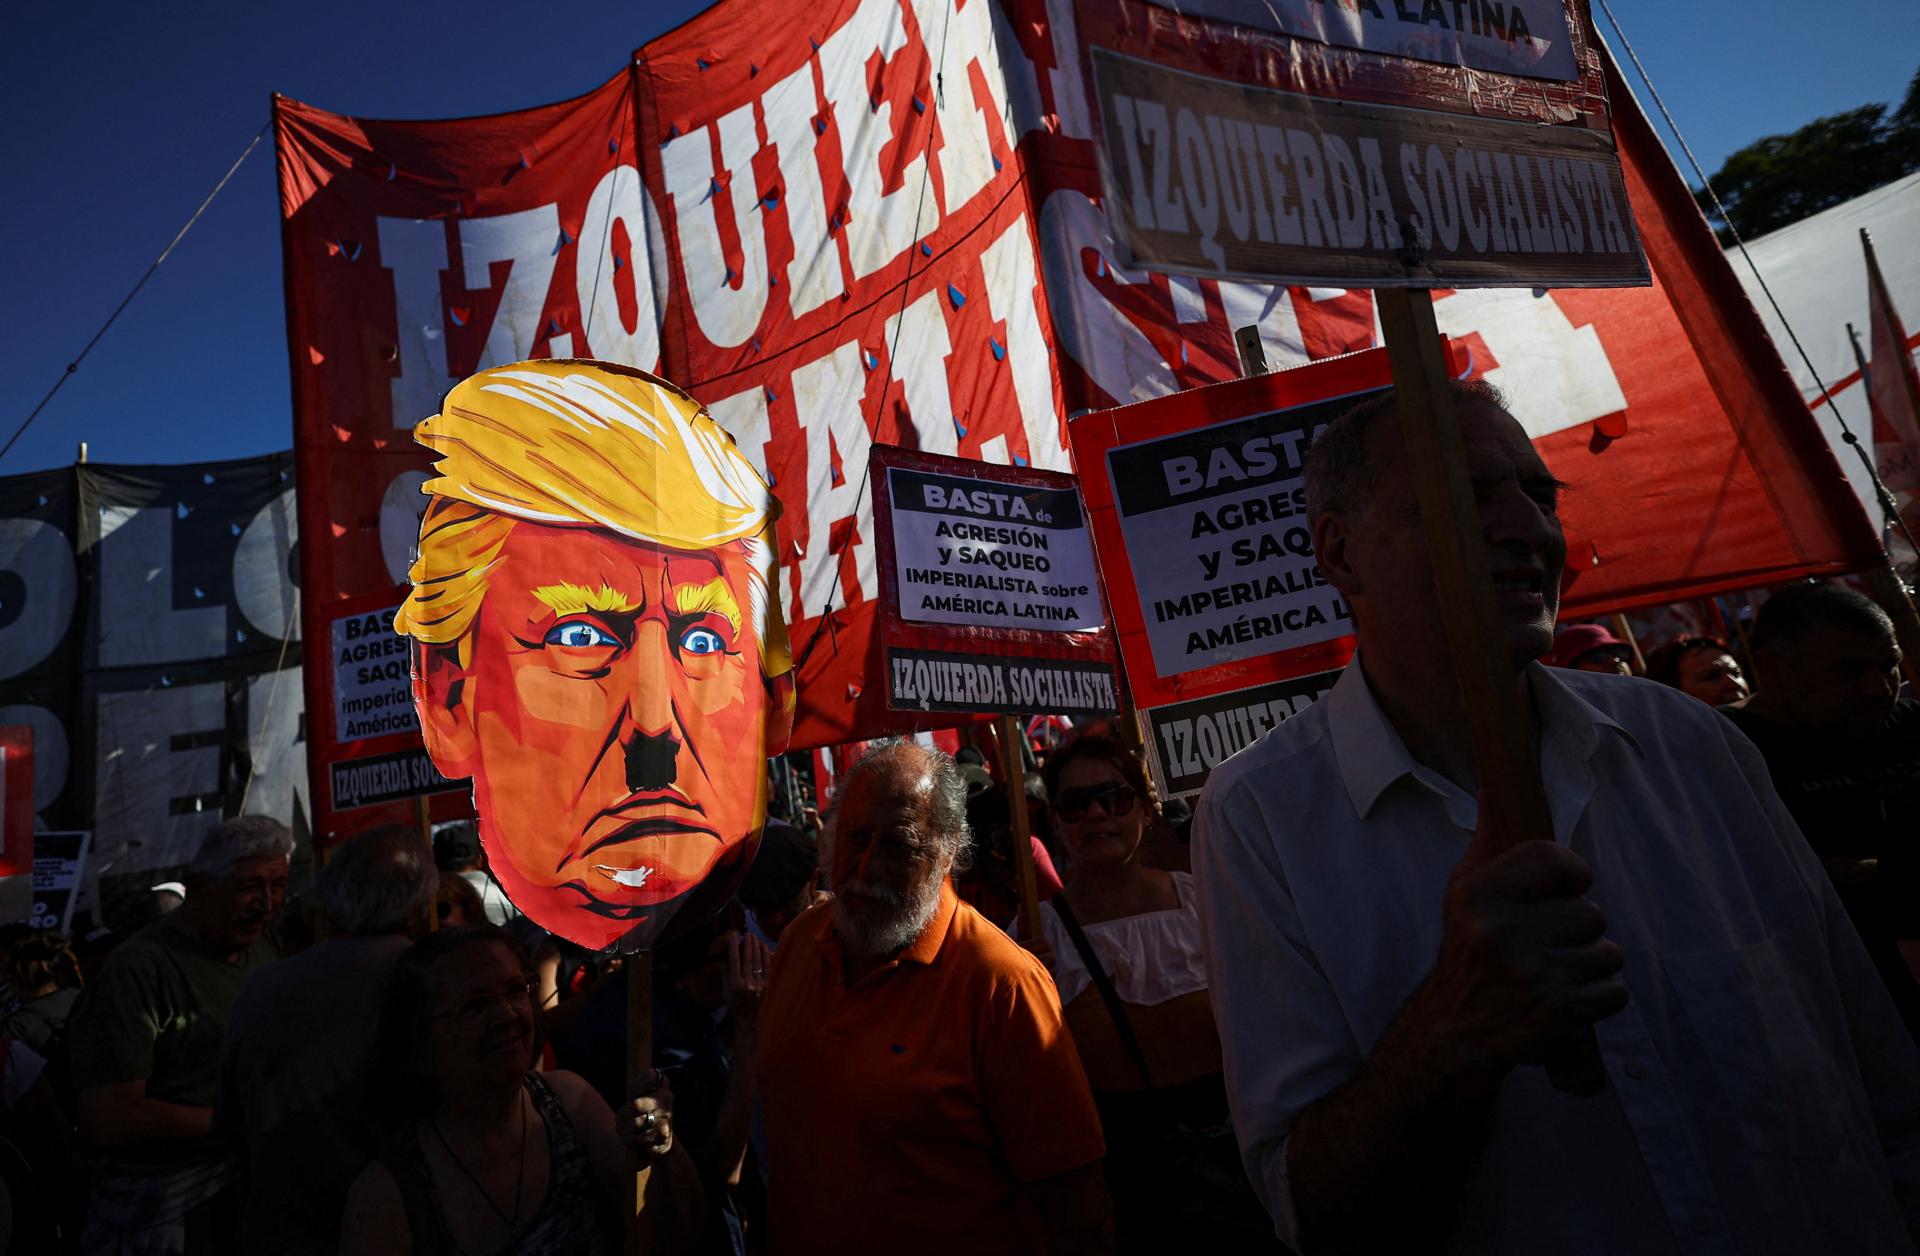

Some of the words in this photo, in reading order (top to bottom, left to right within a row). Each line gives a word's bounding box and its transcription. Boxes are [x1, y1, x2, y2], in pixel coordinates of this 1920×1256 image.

[1113, 94, 1400, 272] IZQUIERDA
[1402, 143, 1631, 254] SOCIALISTA
[1161, 423, 1329, 497] BAST
[923, 484, 1033, 520] BASTA
[1035, 509, 1053, 523] de
[936, 521, 1048, 550] AGRESIÓN
[938, 547, 952, 565] y
[959, 547, 1050, 573] SAQUEO
[1198, 551, 1221, 580] y
[1231, 527, 1315, 567] SAQ
[906, 568, 1038, 594] IMPERIALISTA
[1042, 585, 1089, 597] sobre
[1154, 566, 1329, 623] IMPERIALIS
[921, 594, 1008, 616] AMÉRICA
[1013, 603, 1079, 621] LATINA
[346, 610, 395, 640] BAS
[1187, 604, 1327, 655] AMÉRICA
[340, 637, 409, 666] AGRES
[358, 659, 410, 684] SAQU
[893, 657, 1008, 711] IZQUIERDA
[1009, 666, 1116, 710] SOCIALISTA
[343, 686, 411, 714] imperial
[346, 711, 411, 738] América
[335, 756, 410, 807] IZQUIERDA
